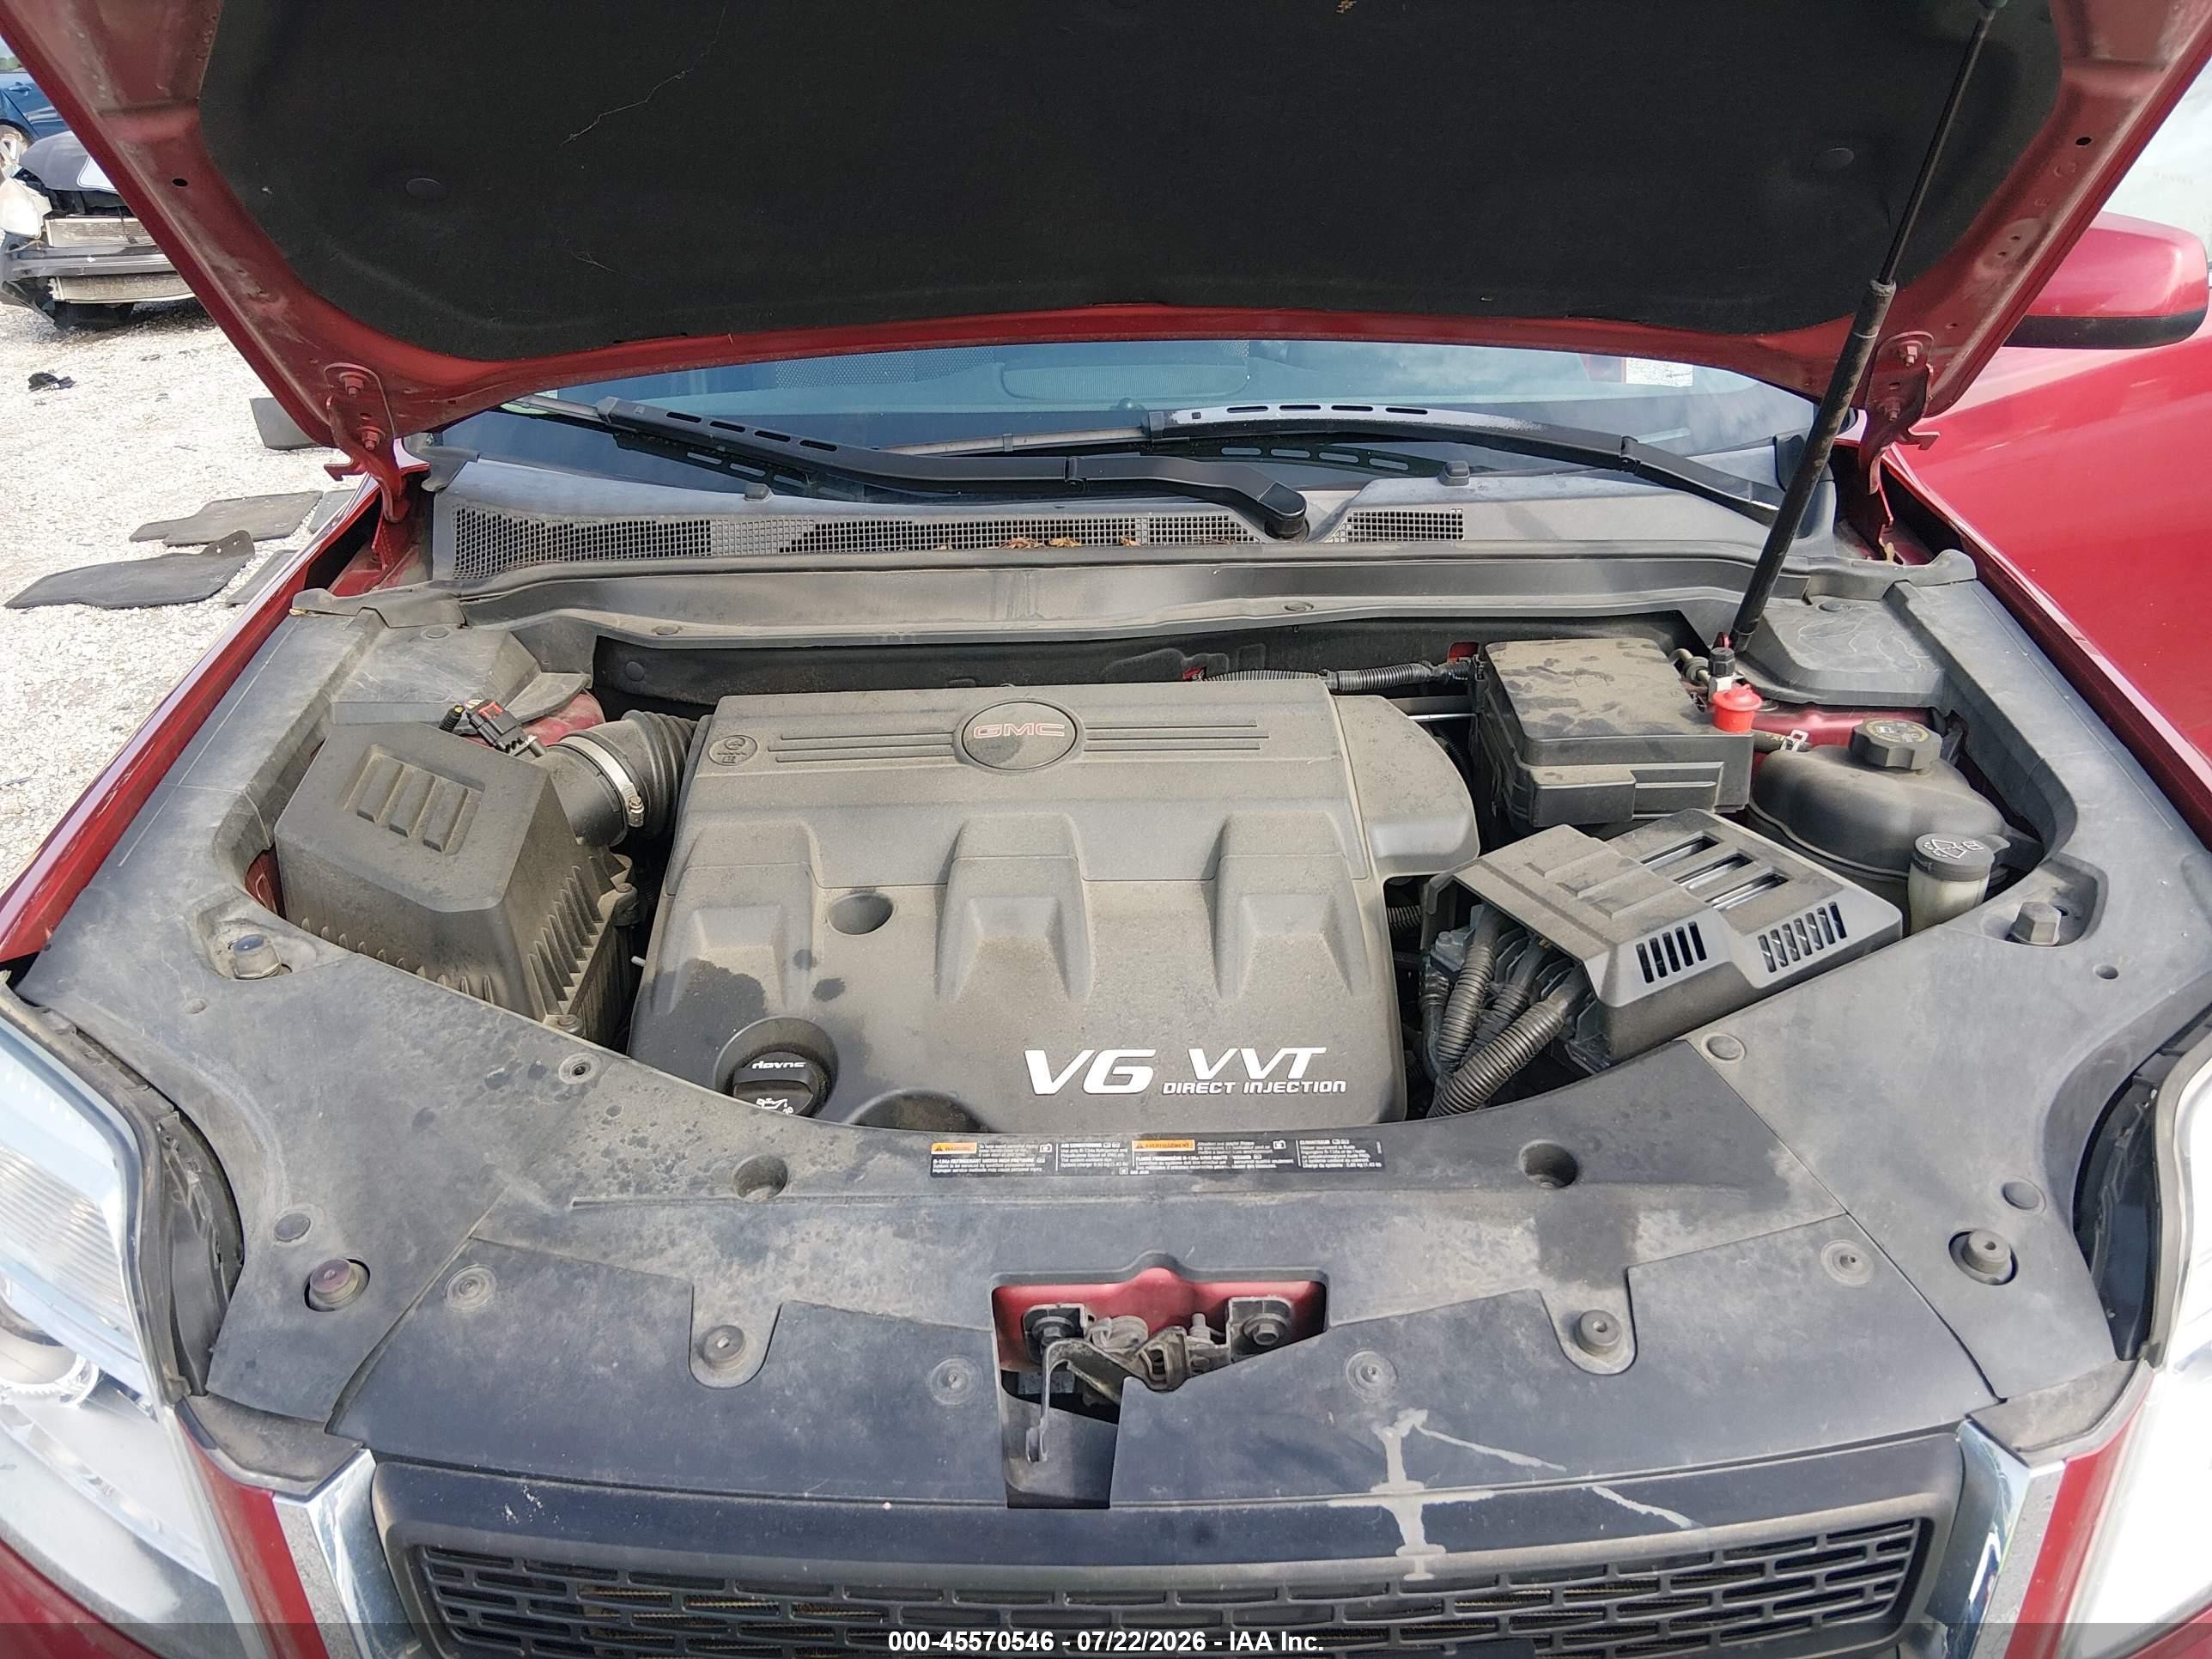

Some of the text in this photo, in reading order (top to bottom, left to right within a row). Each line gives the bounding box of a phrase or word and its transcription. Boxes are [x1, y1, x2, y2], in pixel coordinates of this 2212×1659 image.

[973, 723, 1066, 738] GMC
[1024, 1047, 1328, 1095] V6 VVT
[1162, 1080, 1346, 1095] DIRECT INJECTION
